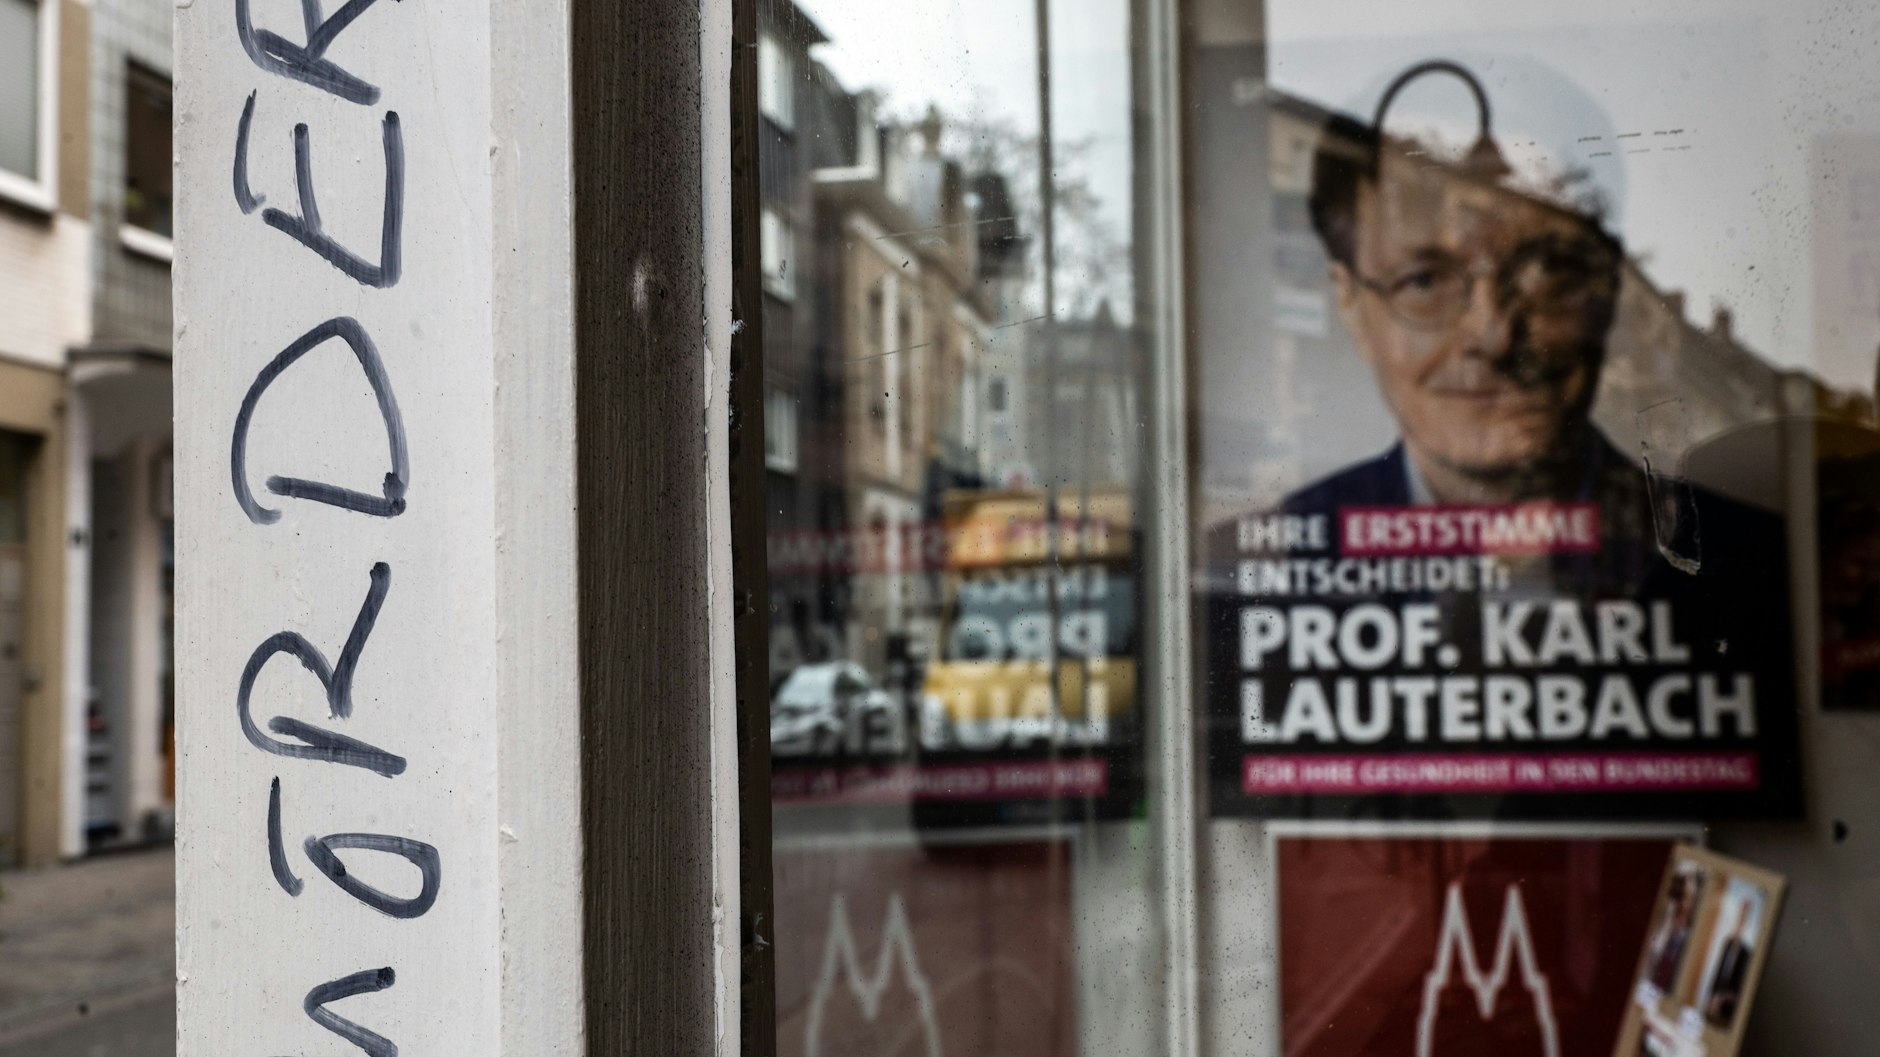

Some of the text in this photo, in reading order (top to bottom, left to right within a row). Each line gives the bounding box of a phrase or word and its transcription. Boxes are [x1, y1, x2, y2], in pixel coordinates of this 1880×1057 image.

[1237, 508, 1595, 552] IHRE ERSTSTIMME
[1236, 557, 1508, 594] ENTSCHEIDET:
[1240, 600, 1691, 669] PROF. KARL
[1241, 674, 1757, 743] LAUTERBACH
[1302, 761, 1354, 786] IHRE
[1514, 760, 1545, 784] IN
[1603, 757, 1750, 785] BUNDESTAG
